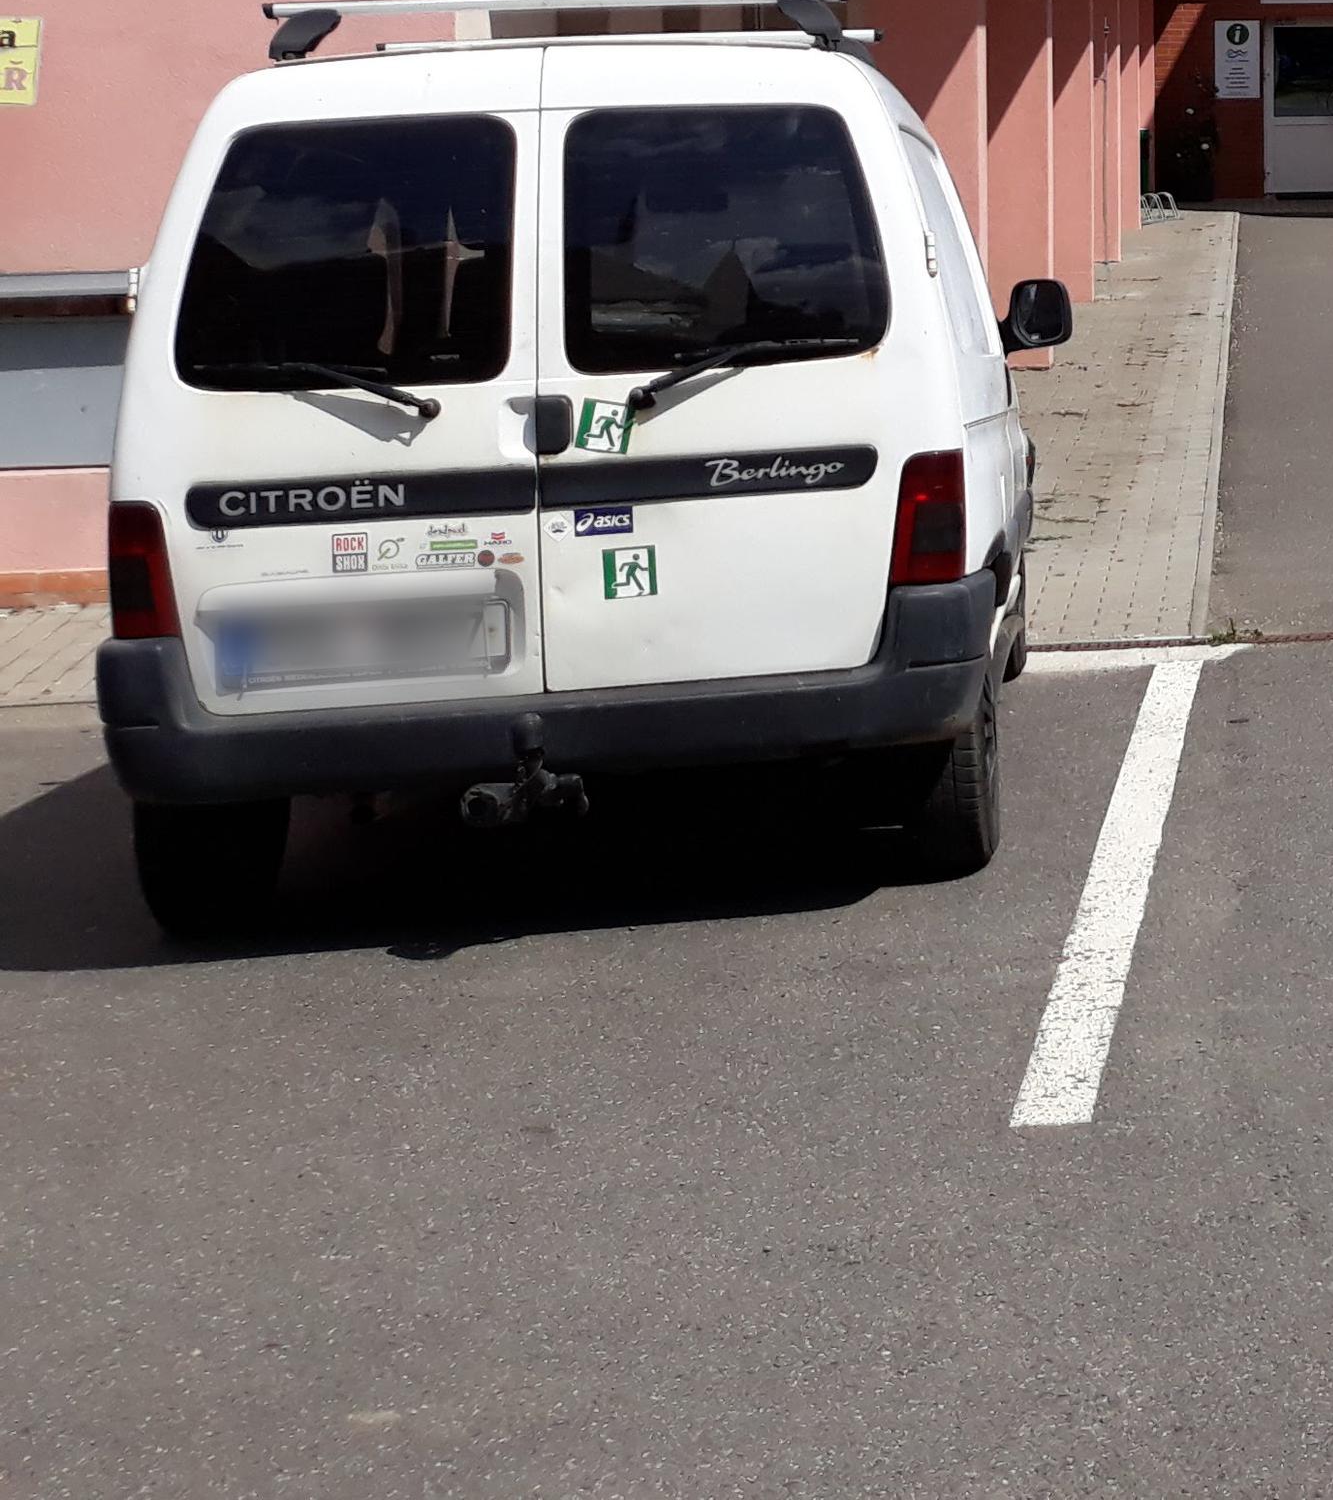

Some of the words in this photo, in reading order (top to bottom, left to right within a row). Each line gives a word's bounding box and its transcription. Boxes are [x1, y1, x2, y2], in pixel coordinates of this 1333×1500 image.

[704, 456, 845, 487] Berlingo
[218, 479, 405, 517] CITROËN
[335, 536, 365, 552] ROCK
[335, 554, 366, 571] SHOX
[416, 552, 475, 566] GALFER
